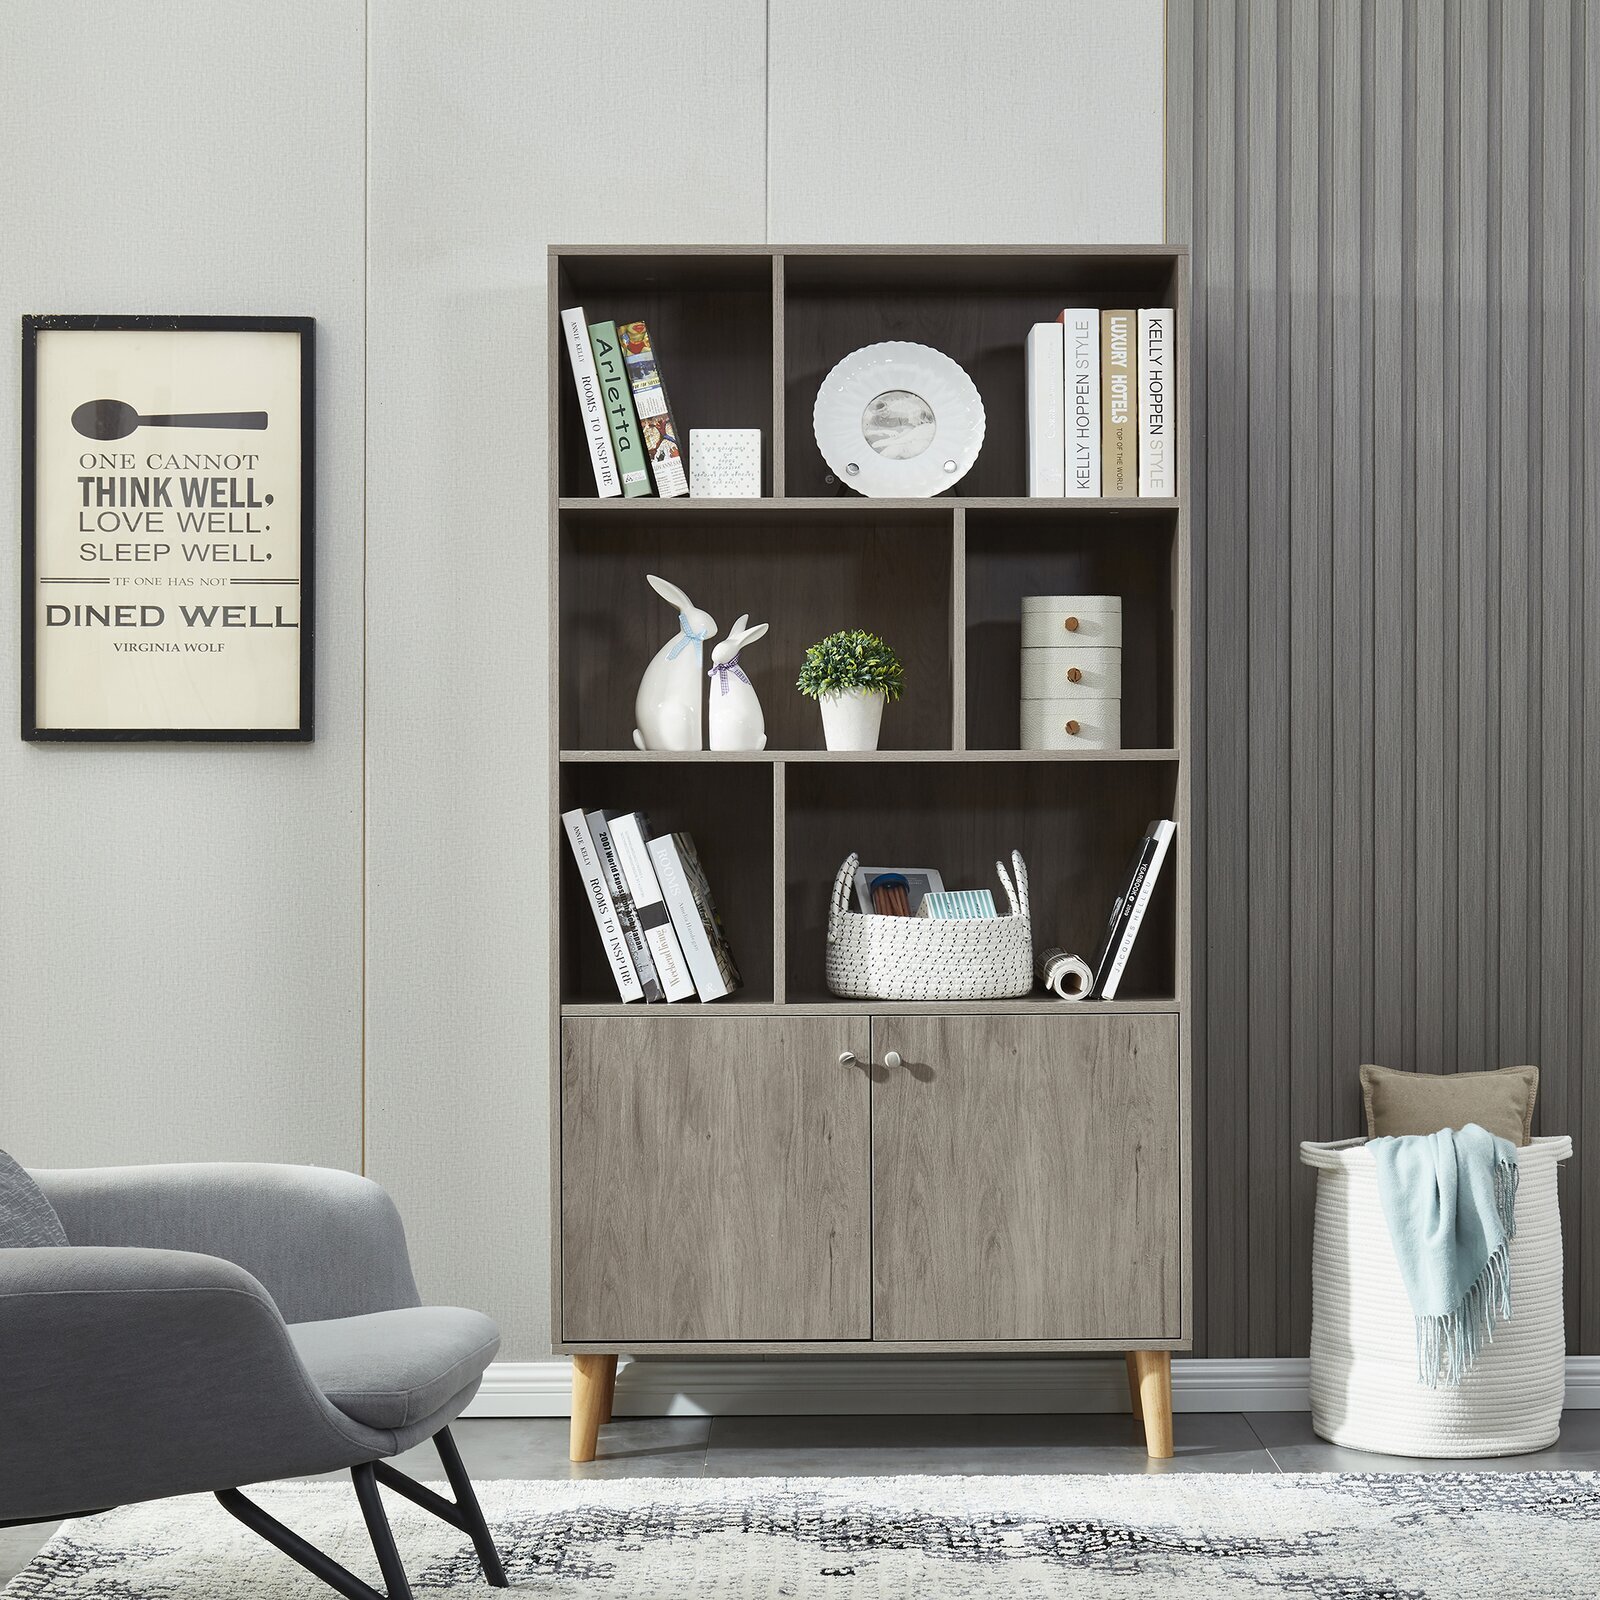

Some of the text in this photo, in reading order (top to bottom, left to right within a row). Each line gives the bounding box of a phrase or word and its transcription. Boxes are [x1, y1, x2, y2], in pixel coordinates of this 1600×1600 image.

[1110, 316, 1128, 368] LUXURY
[571, 321, 614, 488] ANNIE KELLY ROOMS TO INSPIRE
[596, 337, 631, 452] Arletta
[1075, 320, 1090, 489] KELLY HOPPEN STYLE
[1111, 374, 1128, 424] HOTELS
[1149, 319, 1164, 488] KELLY HOPPEN STYLE
[79, 453, 259, 470] ONE CANNOT
[1116, 442, 1123, 451] OF
[77, 476, 274, 508] THINK WELL,
[79, 511, 164, 533] LOVE
[79, 543, 171, 562] SLEEP
[134, 577, 162, 587] ONE
[168, 577, 195, 587] HAS
[200, 577, 228, 587] NOT
[46, 604, 299, 628] DINED WELL
[113, 642, 225, 653] VIRGINIA WOLF
[599, 831, 611, 850] 2007
[605, 850, 618, 873] World
[631, 928, 643, 951] Japan
[656, 848, 681, 897] ROOMS
[1131, 862, 1149, 896] YEARBOOK
[573, 825, 584, 845] ANNIE
[580, 846, 591, 866] KELLY
[589, 877, 609, 915] ROOMS
[603, 917, 615, 934] TO
[609, 936, 633, 986] INSPIRE
[1115, 881, 1151, 973] JACQUES HELLEU
[656, 929, 680, 987] Weekend living
